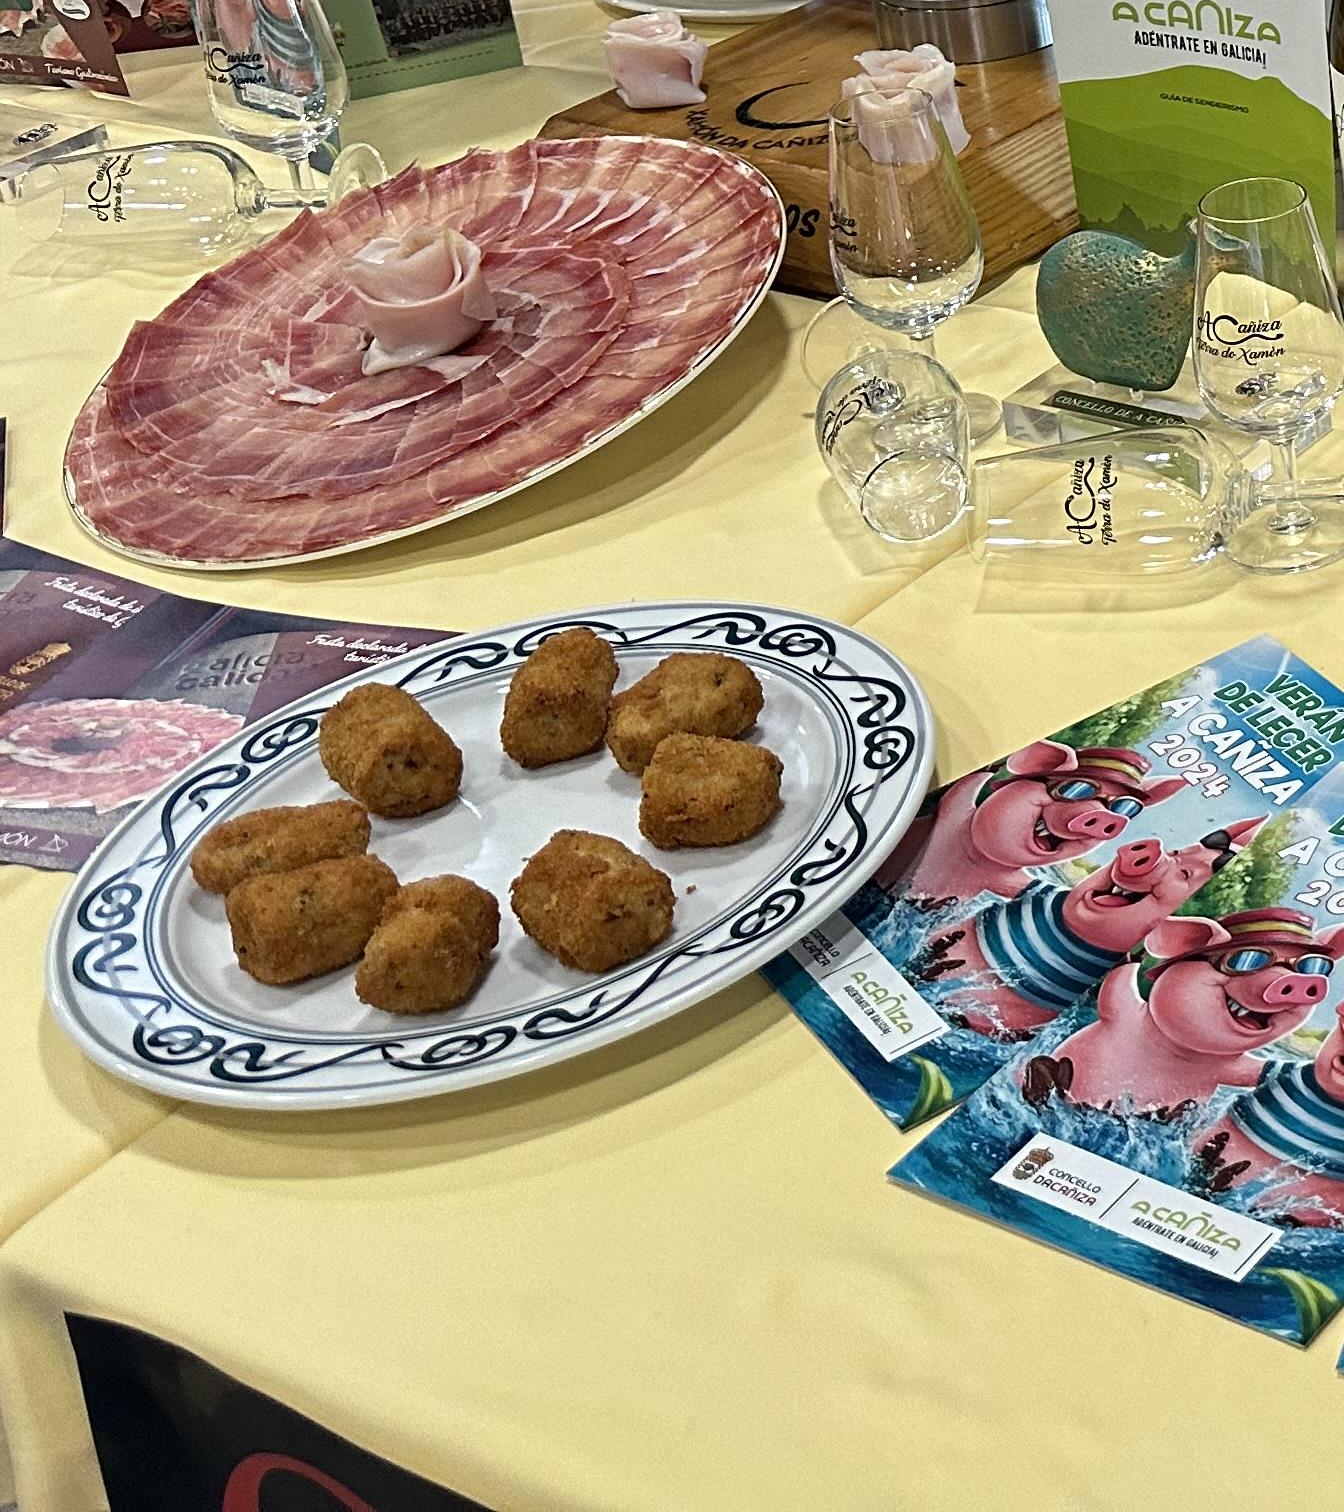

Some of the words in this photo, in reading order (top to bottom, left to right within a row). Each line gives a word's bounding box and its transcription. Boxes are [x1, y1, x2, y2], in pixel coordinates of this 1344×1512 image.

[1112, 2, 1139, 23] A
[1134, 30, 1200, 53] ADÉNTRATE
[1204, 40, 1218, 55] EN
[1213, 315, 1284, 345] Cañiza
[1055, 395, 1113, 413] CONCELLO
[1114, 408, 1131, 418] DE
[1213, 680, 1252, 715] DE
[1245, 703, 1336, 774] LECER
[1160, 694, 1203, 721] A
[1187, 711, 1306, 806] CAÑIZA
[1148, 733, 1232, 799] 2024
[1276, 836, 1322, 866] A
[1048, 1166, 1102, 1196] CONCELLO
[1152, 1208, 1242, 1252] CAÑIZA
